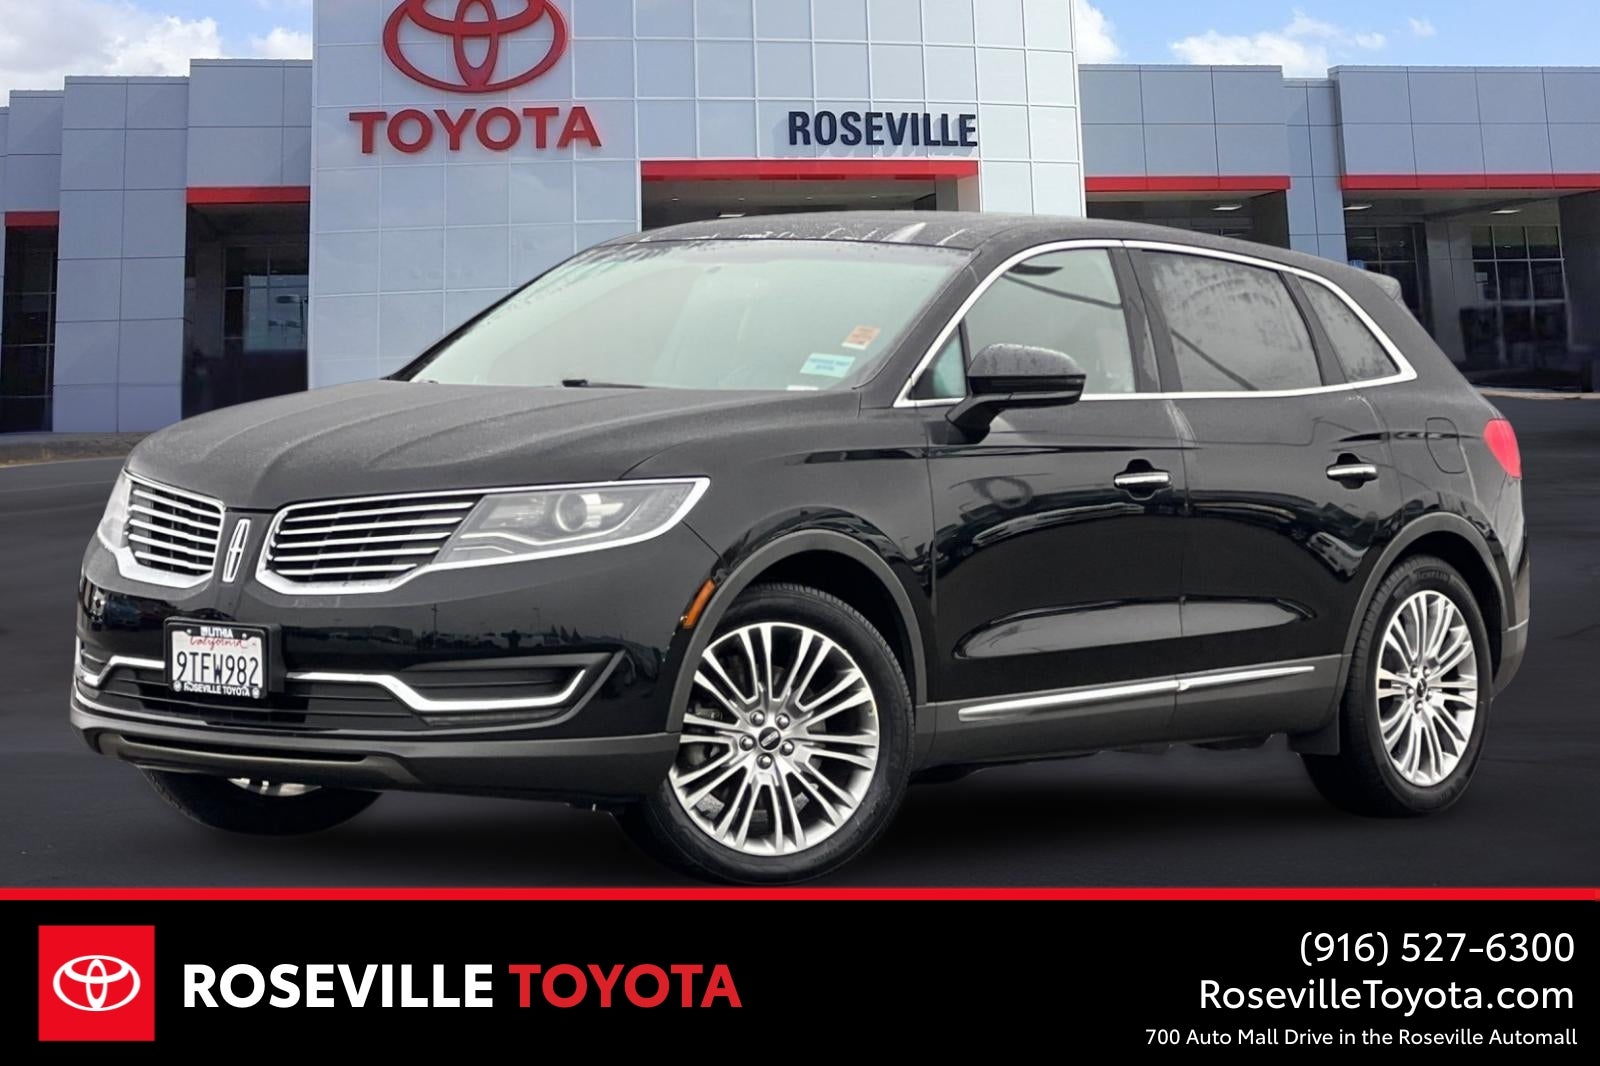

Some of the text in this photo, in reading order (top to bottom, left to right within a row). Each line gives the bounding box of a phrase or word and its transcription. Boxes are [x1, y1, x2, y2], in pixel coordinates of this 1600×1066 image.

[349, 106, 602, 154] TOYOTA
[788, 110, 978, 147] ROSEVILLE
[189, 637, 247, 651] California
[208, 626, 234, 638] LITHIA
[177, 651, 259, 686] 9TFW982
[183, 681, 251, 697] ROSEVILLE TOYOTA
